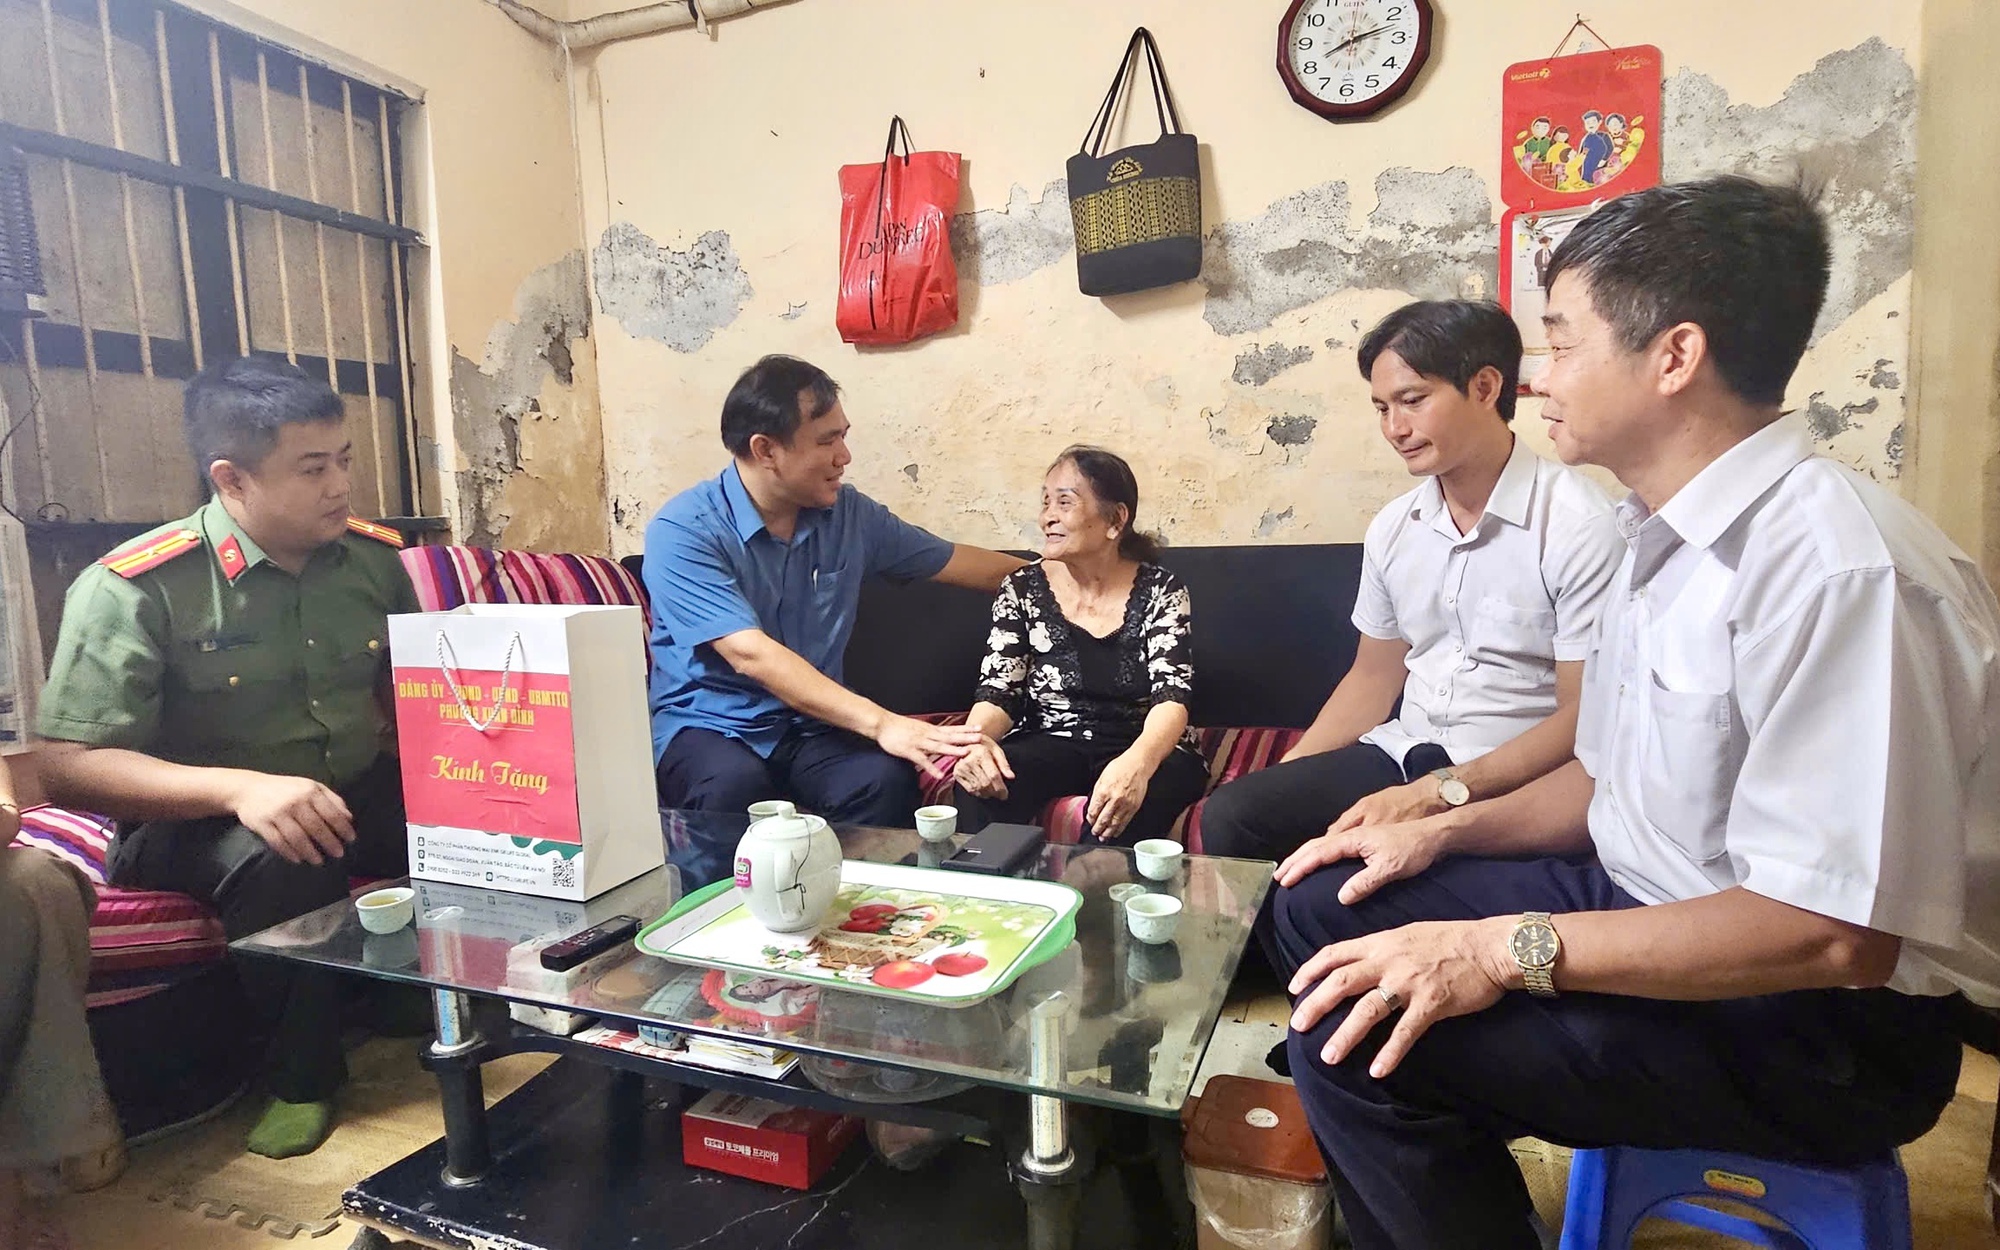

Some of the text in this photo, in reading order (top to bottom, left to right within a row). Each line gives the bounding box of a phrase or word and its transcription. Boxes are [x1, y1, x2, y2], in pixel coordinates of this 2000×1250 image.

[1307, 14, 1325, 27] 10
[1386, 7, 1402, 21] 2
[1298, 37, 1313, 51] 9
[1391, 31, 1406, 45] 3
[1303, 61, 1318, 74] 8
[1381, 56, 1397, 69] 4
[1318, 77, 1331, 91] 7
[1364, 75, 1380, 88] 5
[1339, 84, 1354, 97] 6
[491, 761, 551, 795] Tặng
